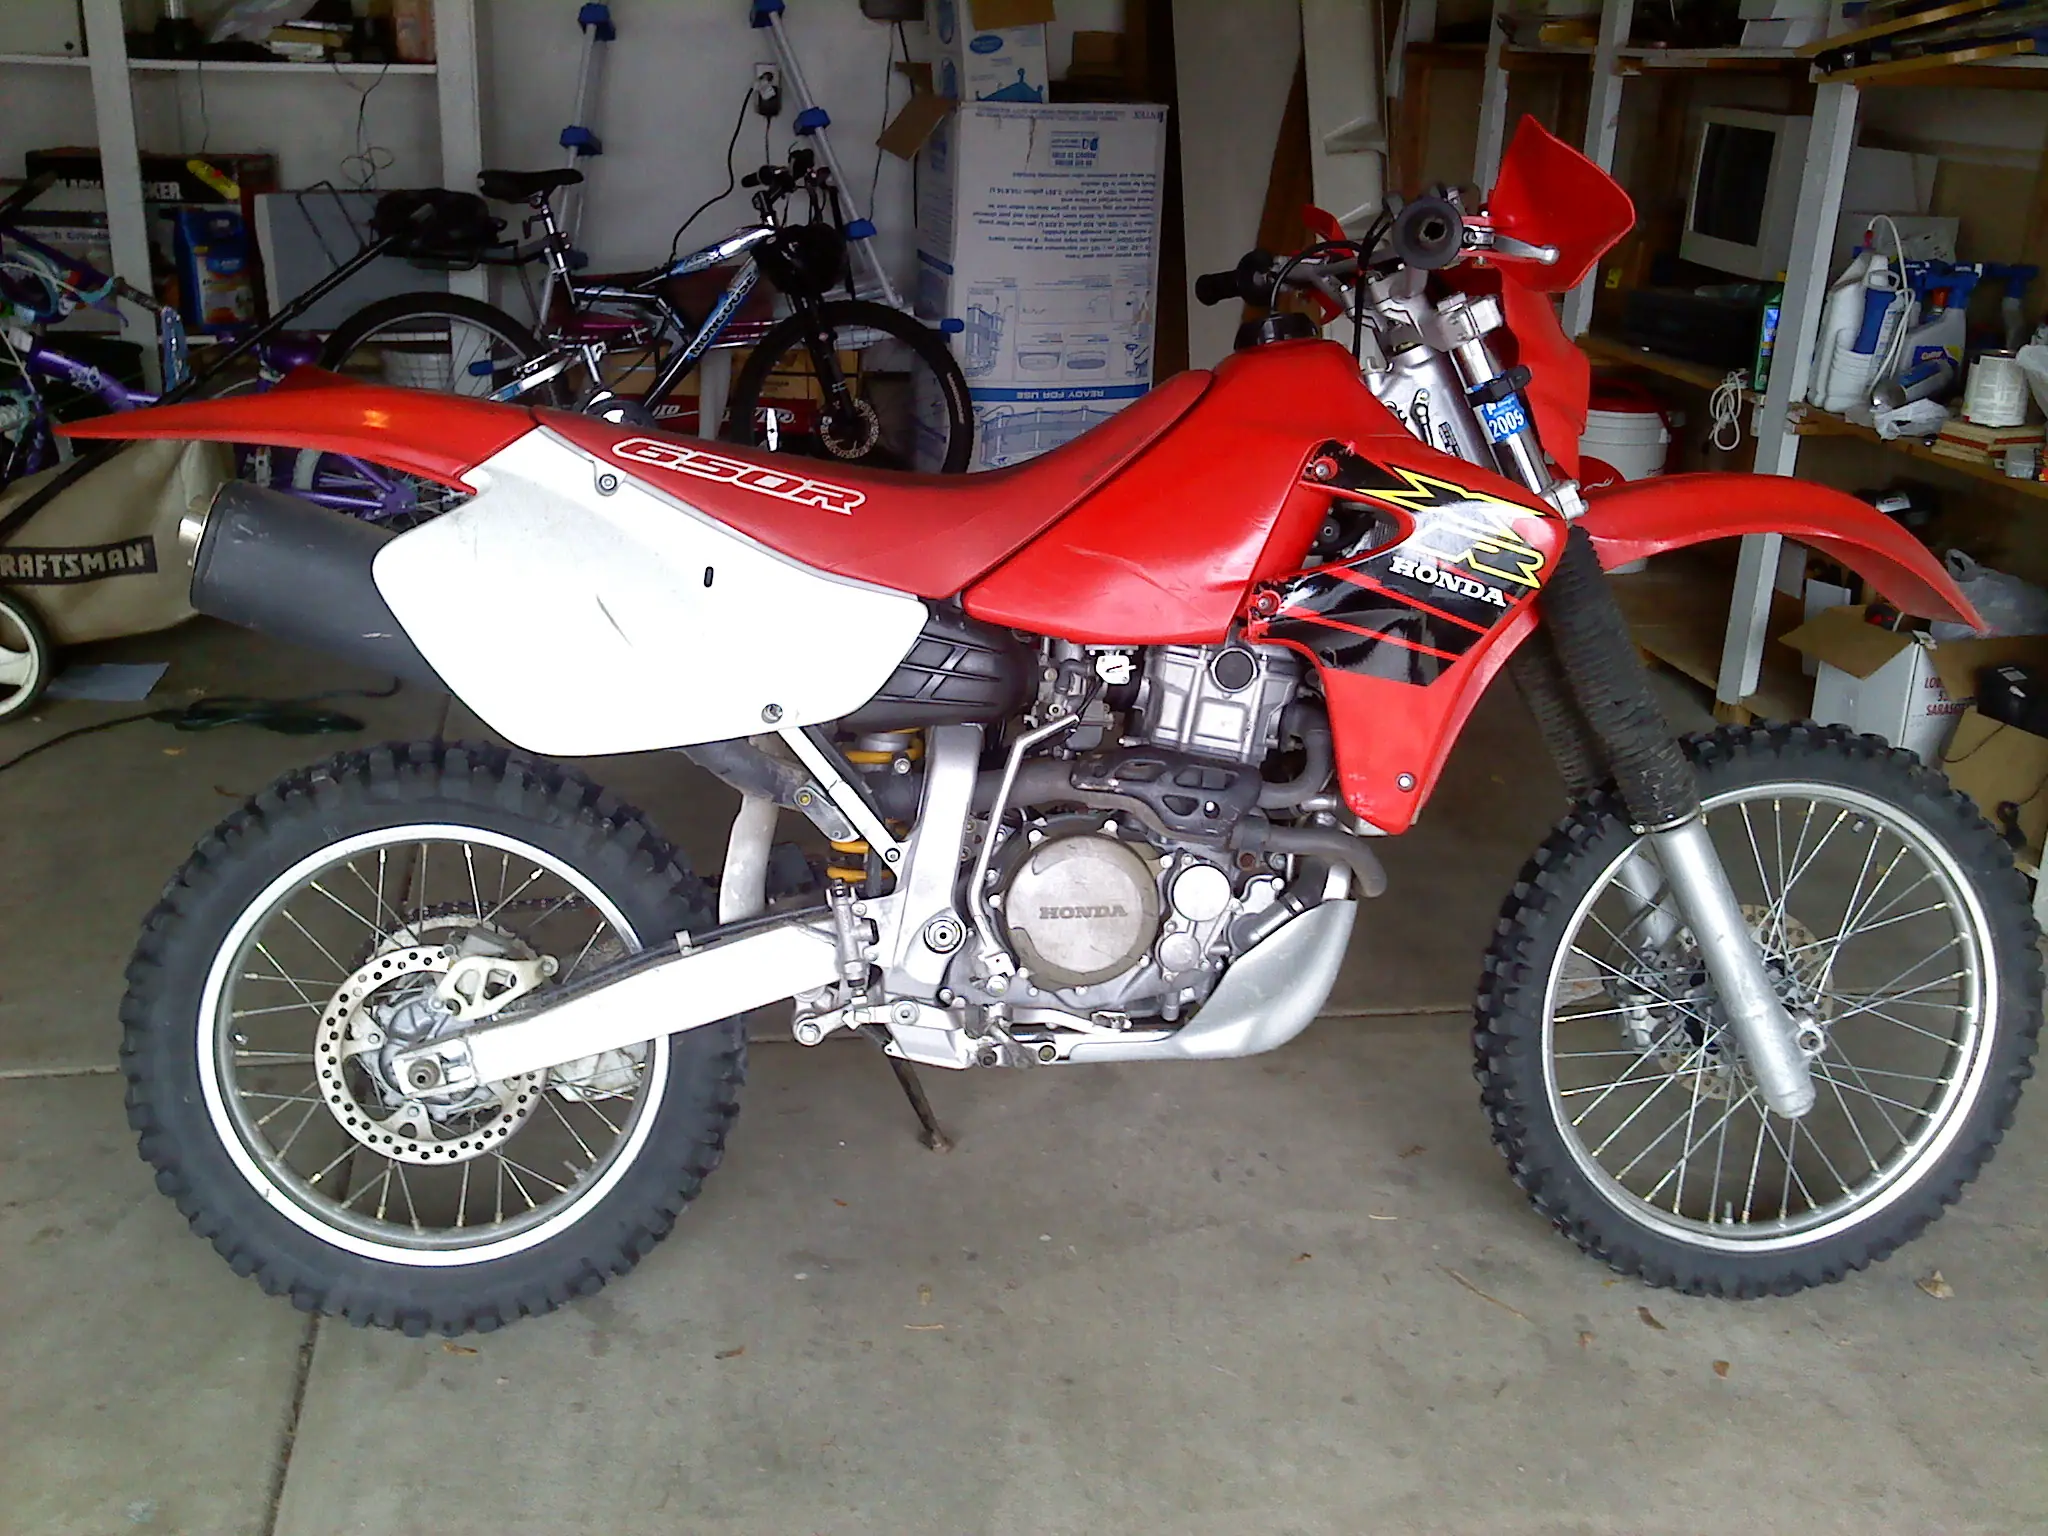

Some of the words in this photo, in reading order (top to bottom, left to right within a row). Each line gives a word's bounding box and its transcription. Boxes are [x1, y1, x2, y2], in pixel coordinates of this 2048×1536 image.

[688, 272, 758, 358] MONGOOSE
[1016, 391, 1039, 400] USE
[1042, 391, 1065, 400] FOR
[1068, 389, 1104, 399] READY
[1488, 409, 1525, 438] 2009
[0, 543, 147, 578] RAFTSMAN
[1389, 556, 1508, 608] HONDA
[1039, 904, 1129, 920] HONDA
